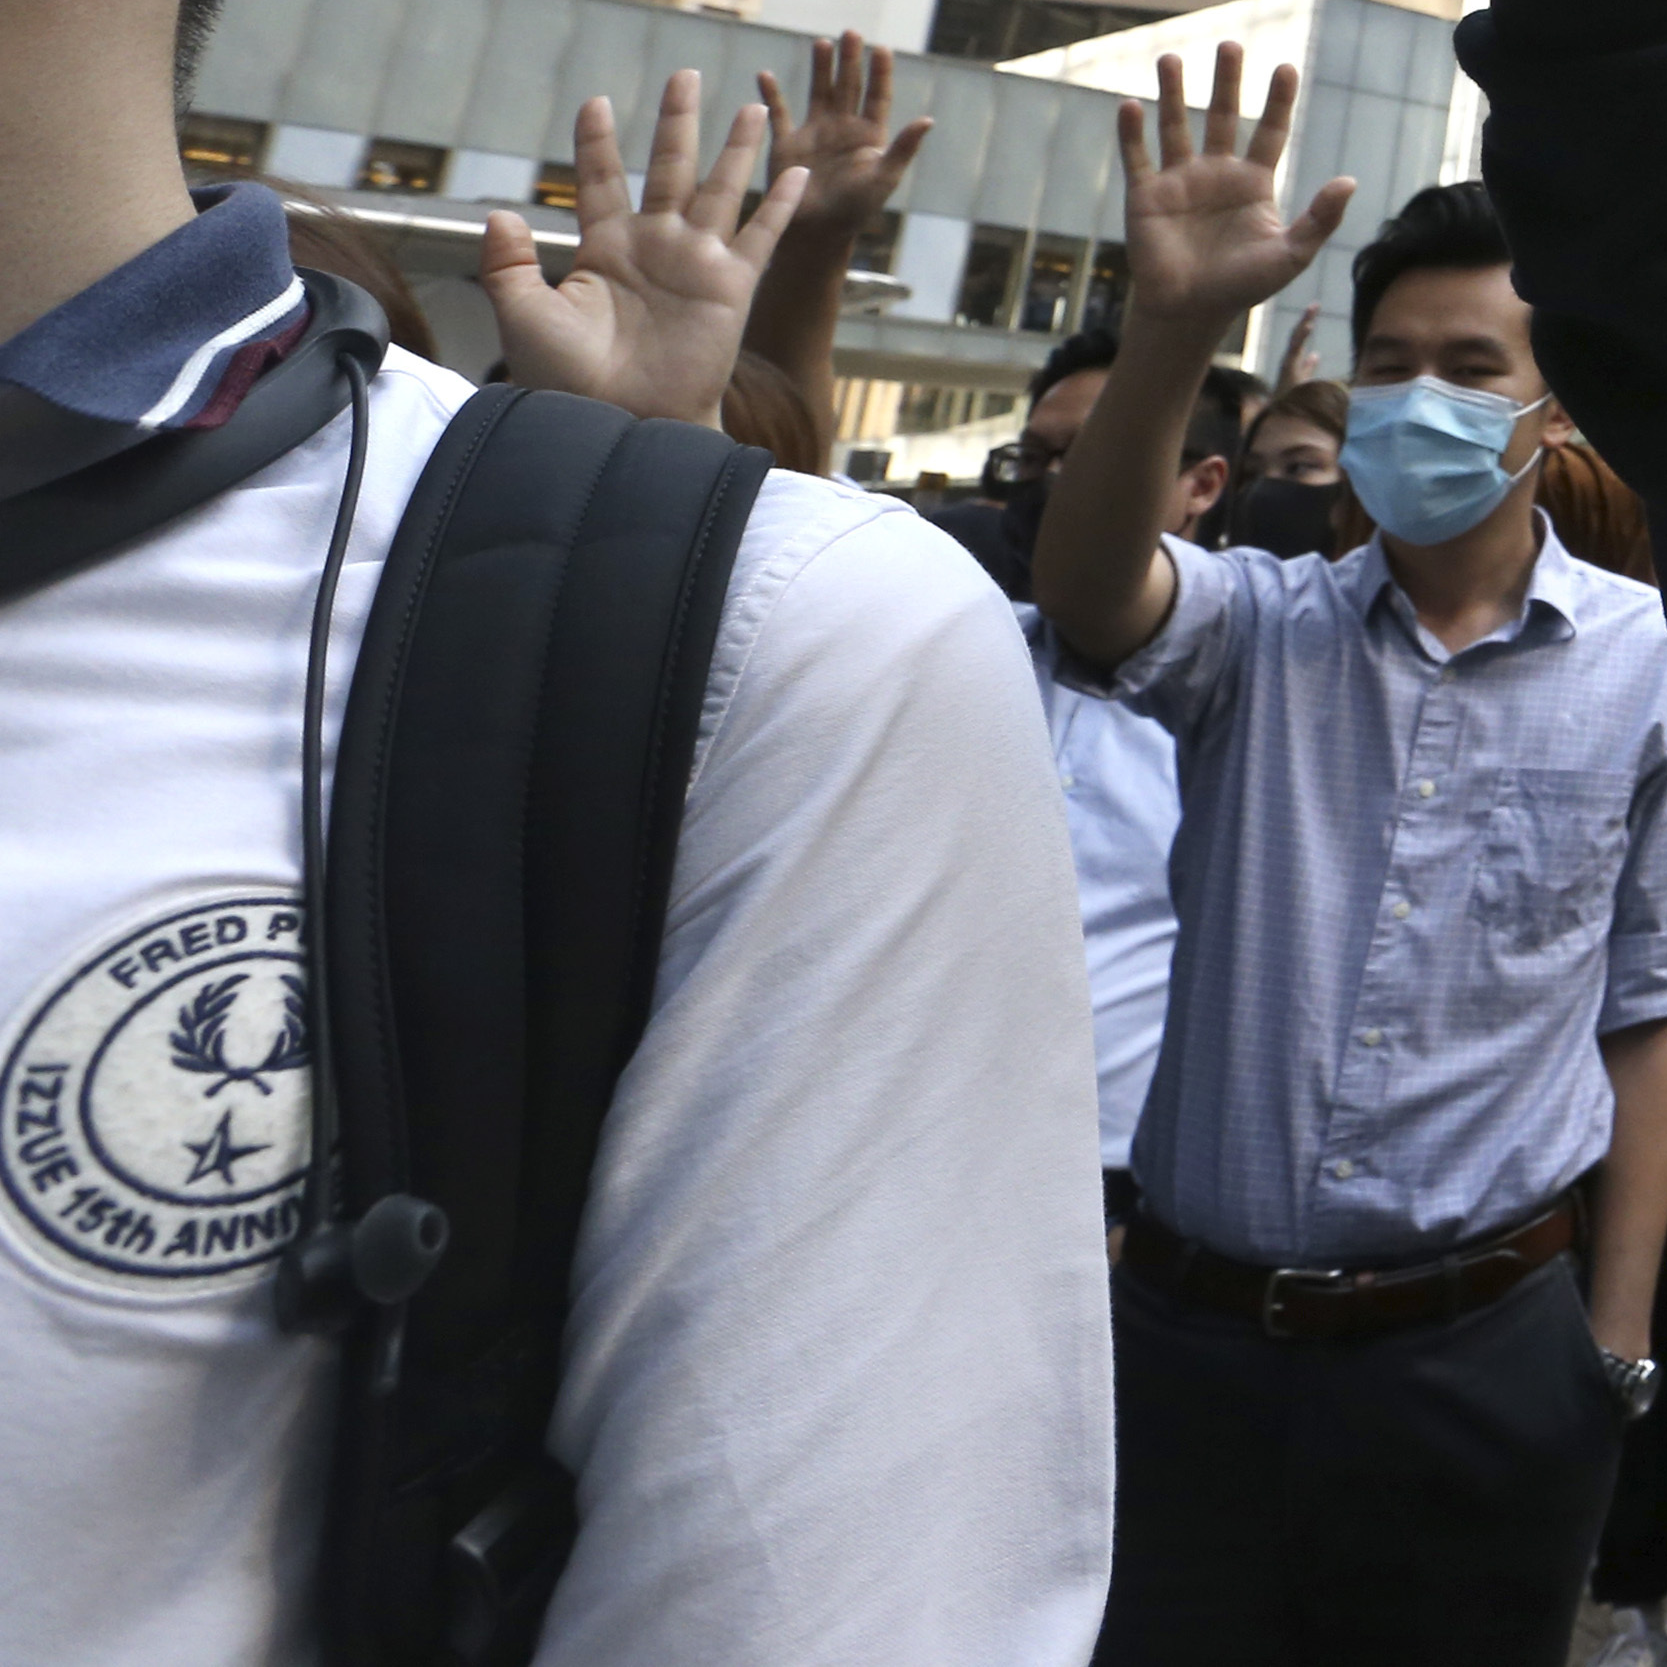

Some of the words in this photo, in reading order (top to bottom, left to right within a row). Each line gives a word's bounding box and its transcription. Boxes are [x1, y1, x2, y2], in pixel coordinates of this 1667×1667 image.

[108, 914, 248, 989] FRED
[16, 1062, 80, 1194] IZZUE
[57, 1186, 156, 1256] 15th
